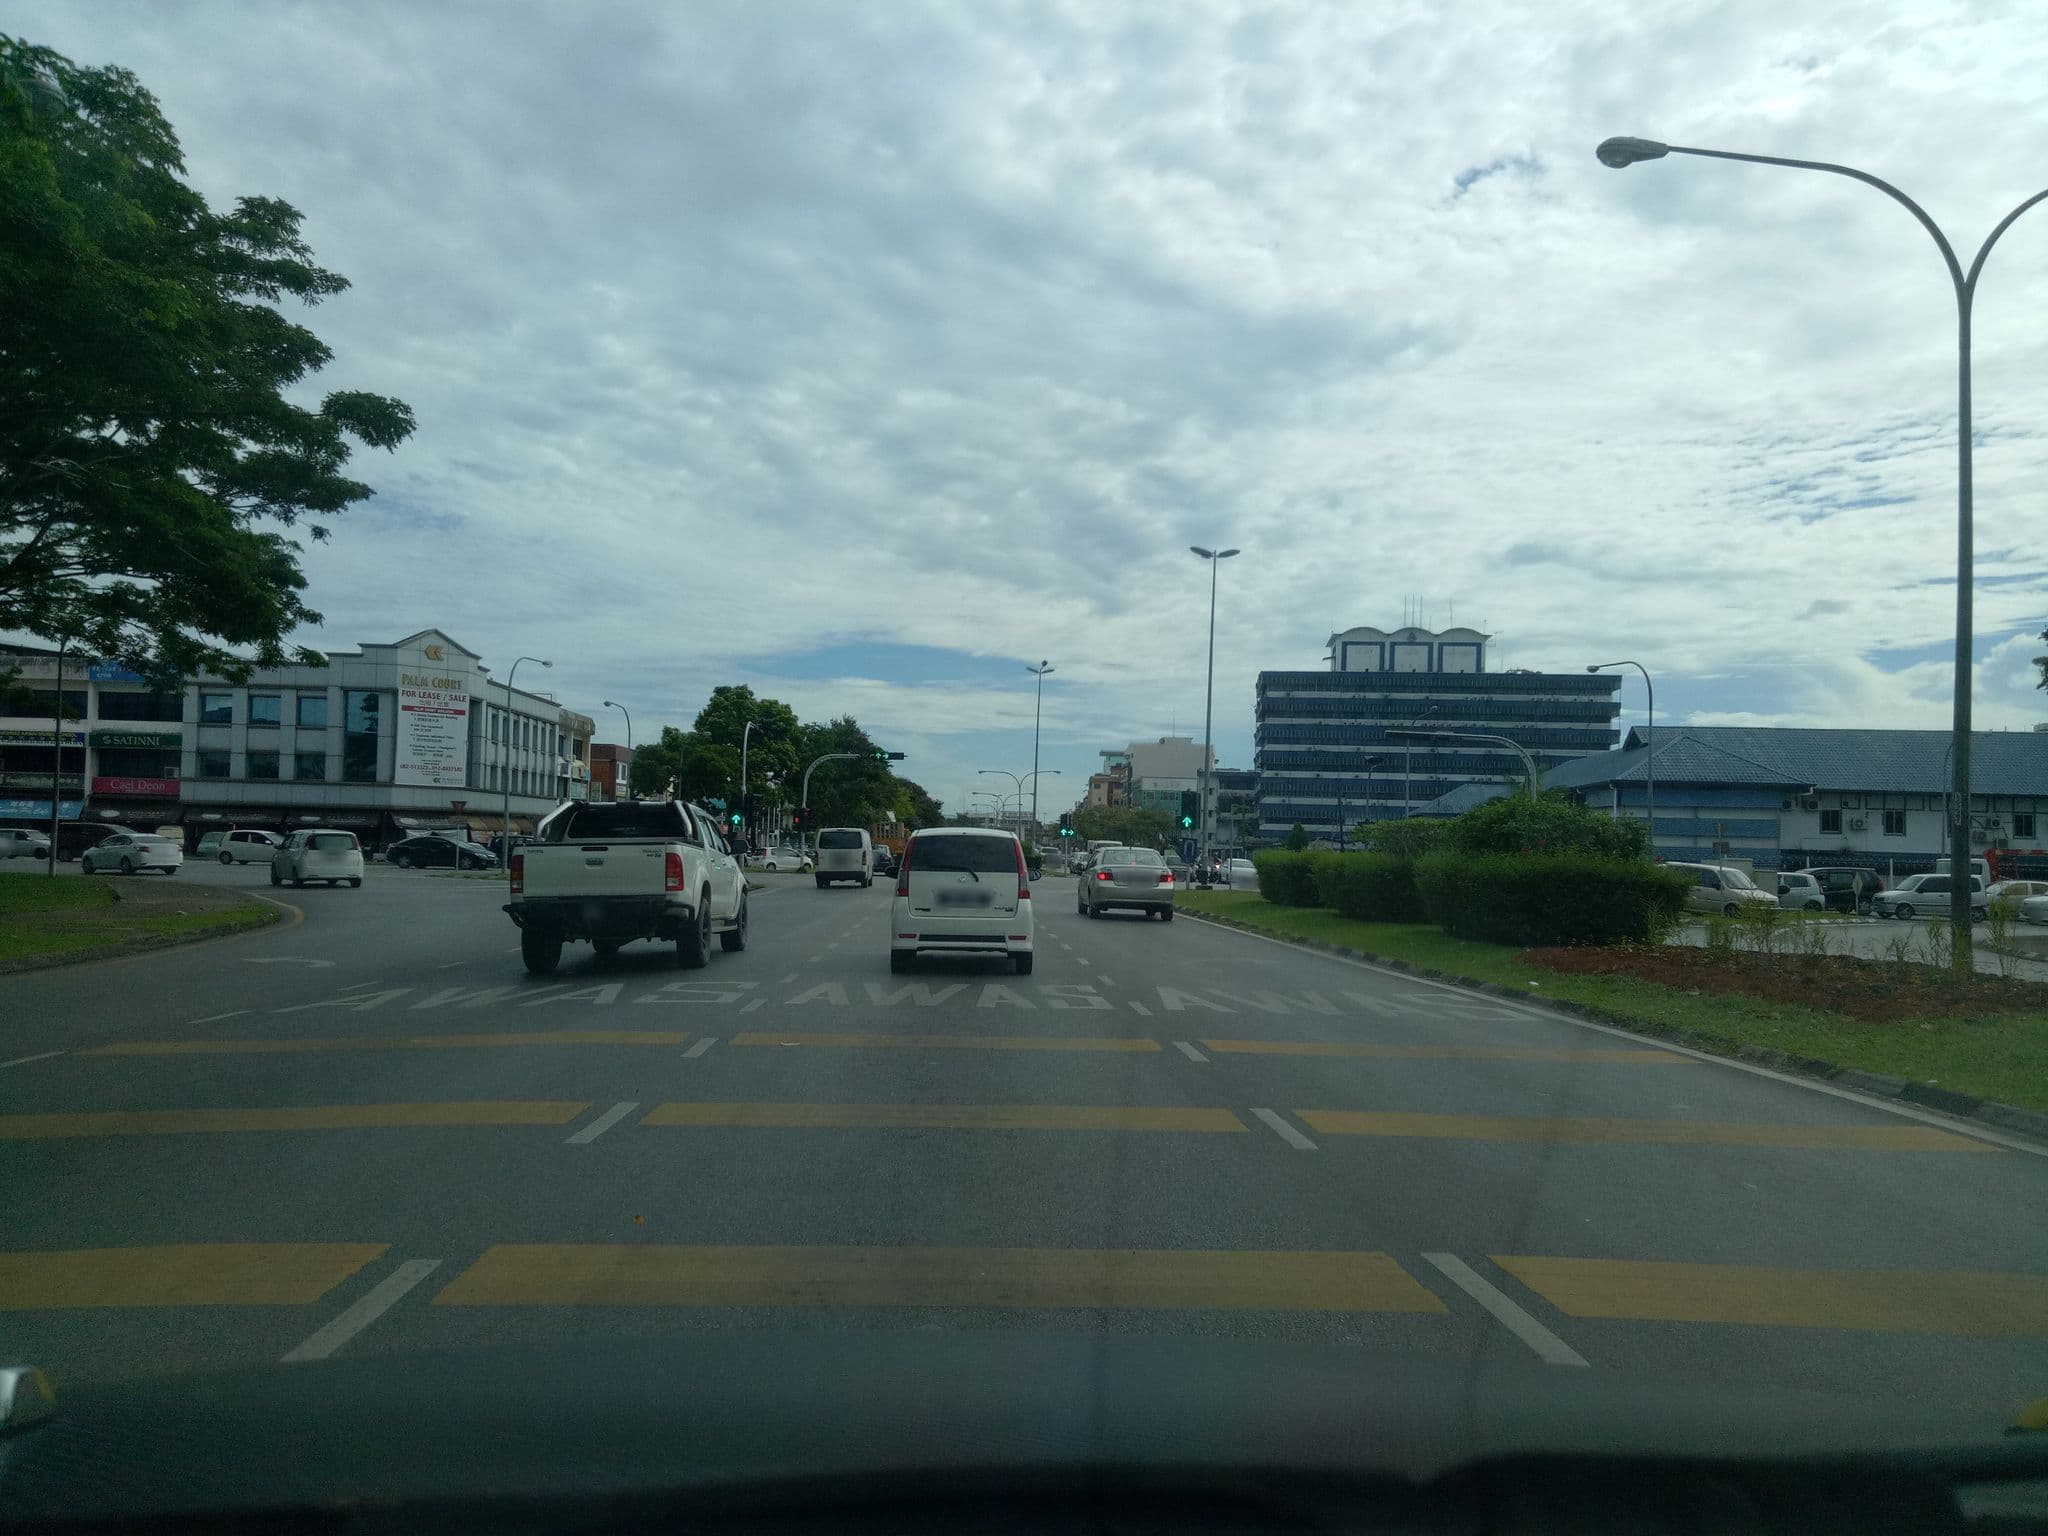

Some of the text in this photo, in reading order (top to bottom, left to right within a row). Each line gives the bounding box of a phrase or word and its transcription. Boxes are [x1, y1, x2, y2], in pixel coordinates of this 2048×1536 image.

[401, 673, 463, 689] PALM COURT
[418, 691, 441, 700] LEASE
[448, 694, 467, 702] SALE
[113, 736, 160, 746] SATINNI
[138, 780, 166, 791] Deon
[783, 982, 1117, 1010] AWAS
